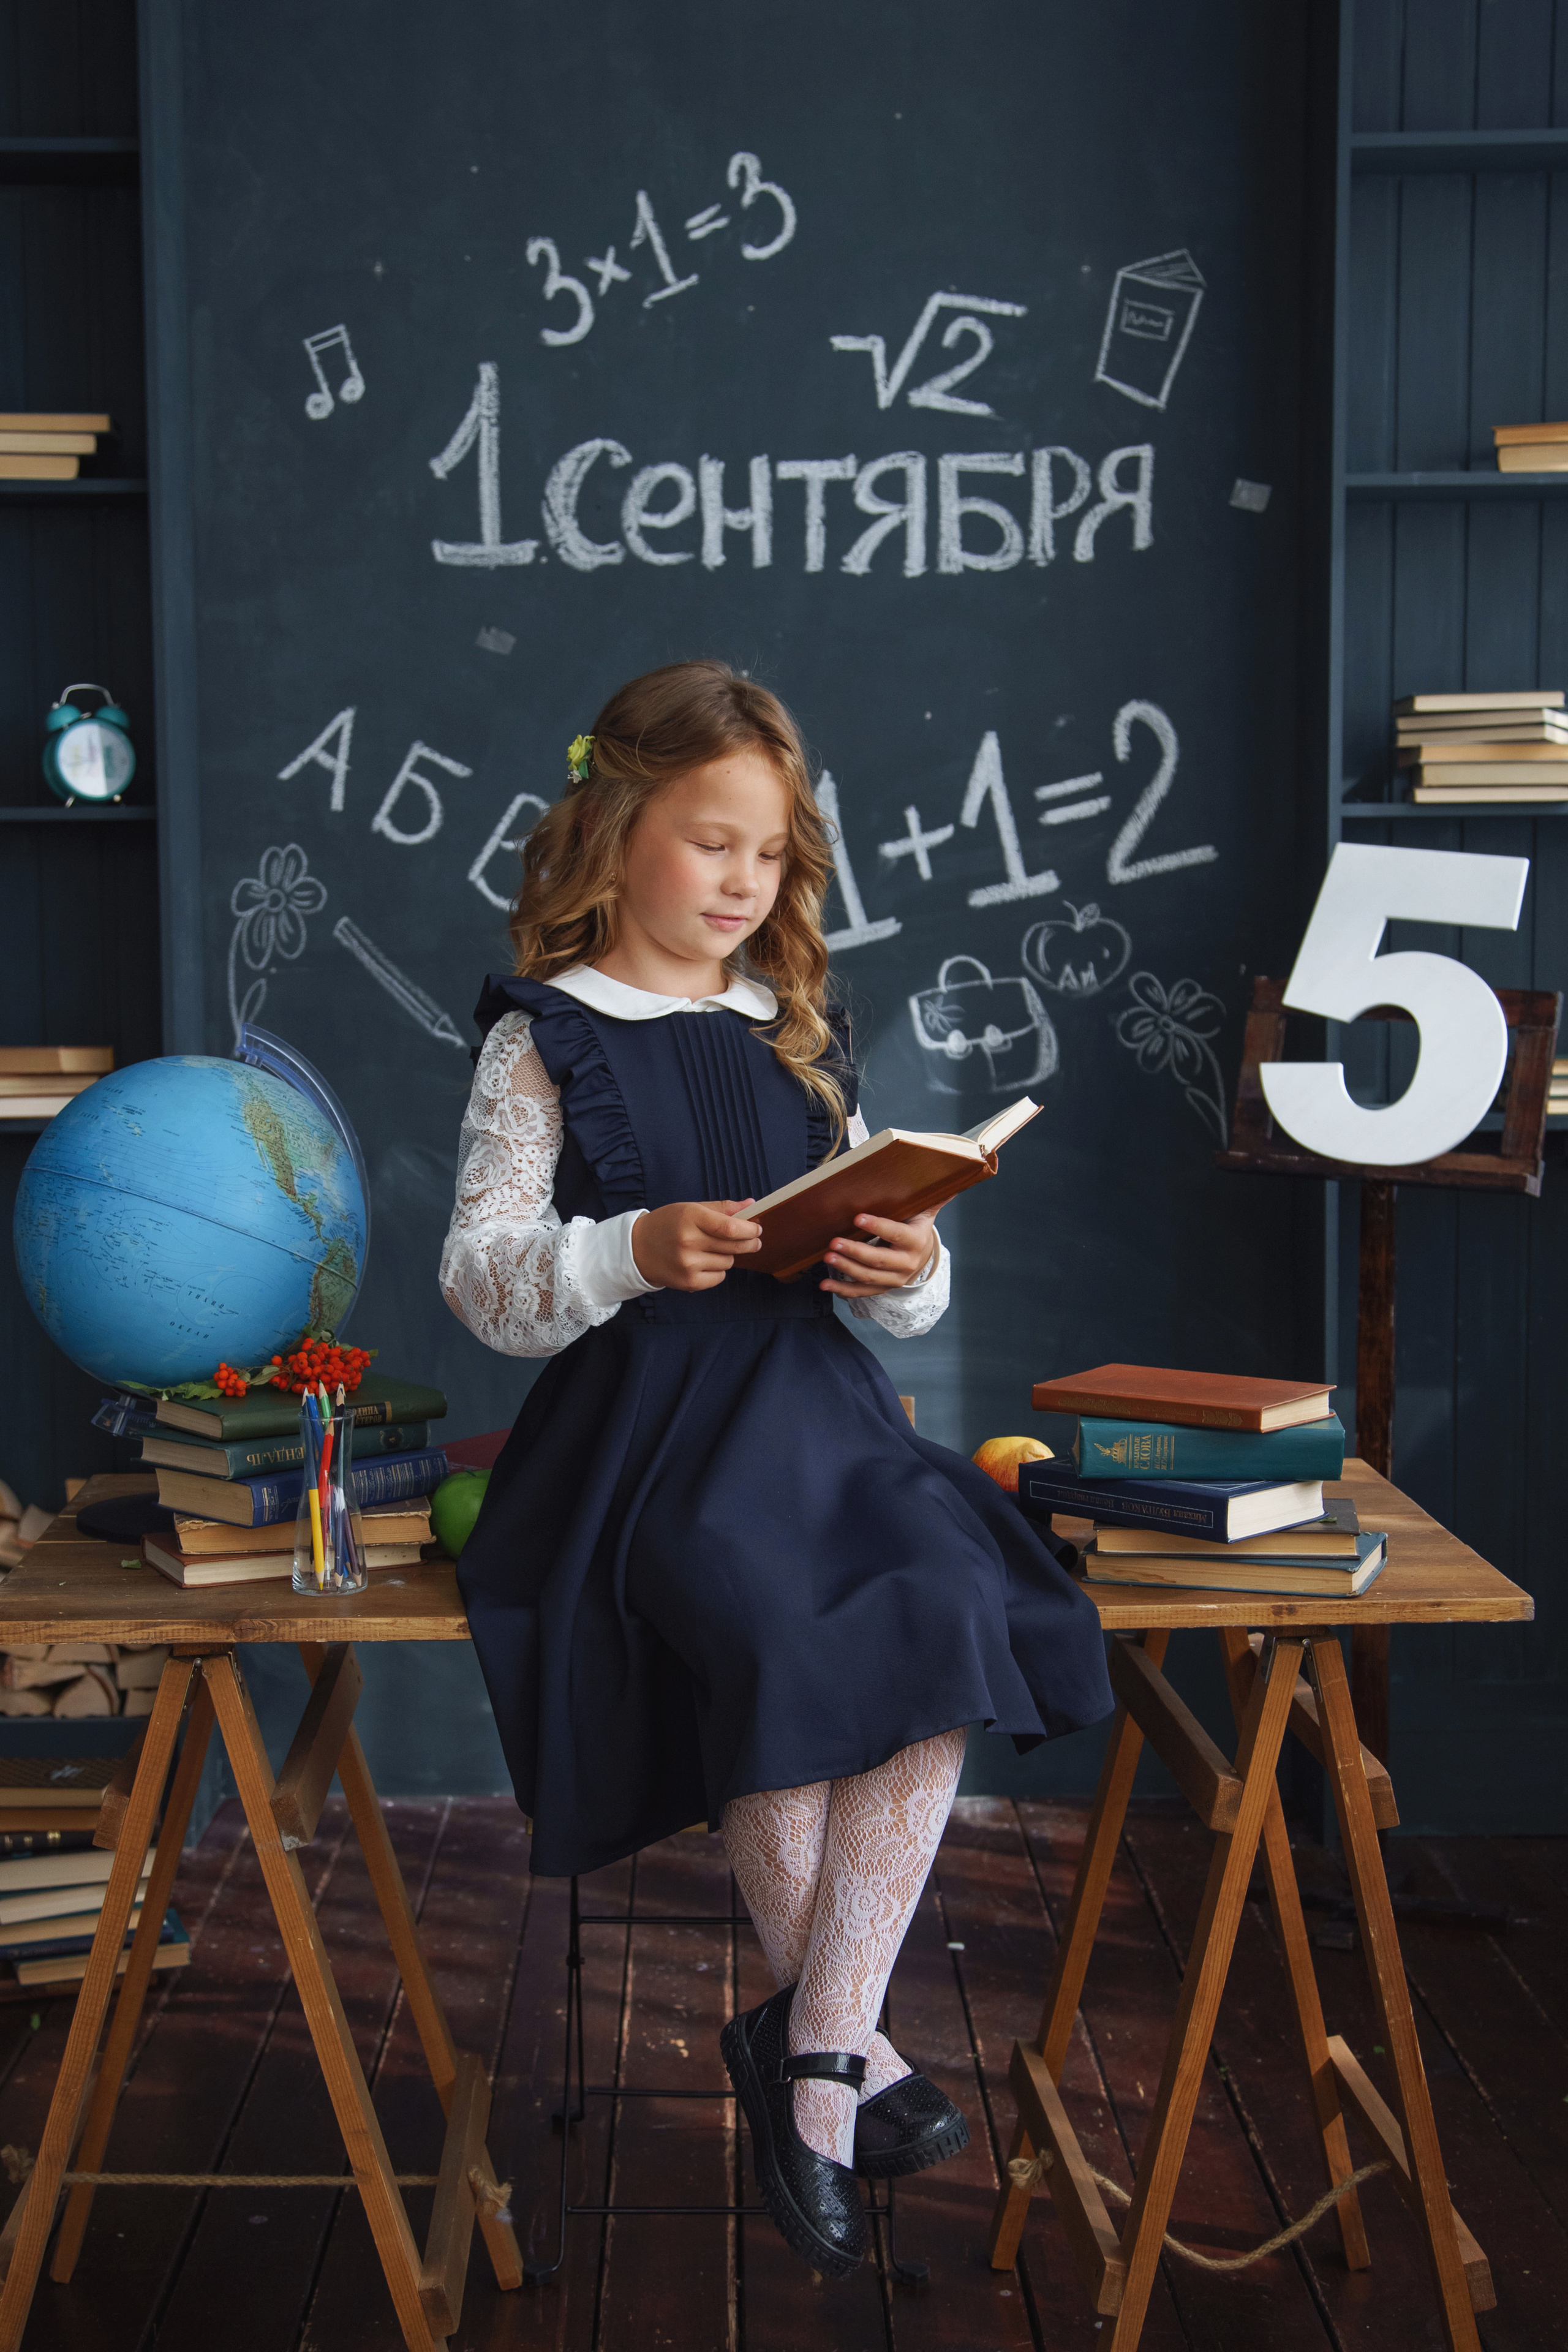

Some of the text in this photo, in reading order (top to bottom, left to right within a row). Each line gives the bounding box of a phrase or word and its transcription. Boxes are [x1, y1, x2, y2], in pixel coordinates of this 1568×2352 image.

[429, 361, 539, 568] 1
[277, 706, 357, 812] А
[372, 740, 474, 845] Б
[1259, 842, 1530, 1166] 5
[246, 1446, 304, 1466] ЕНДАЛЬ
[1140, 1434, 1152, 1469] СЛОВА
[1122, 1502, 1170, 1518] БУЛГАКОВ
[1174, 1509, 1207, 1524] Михаил
